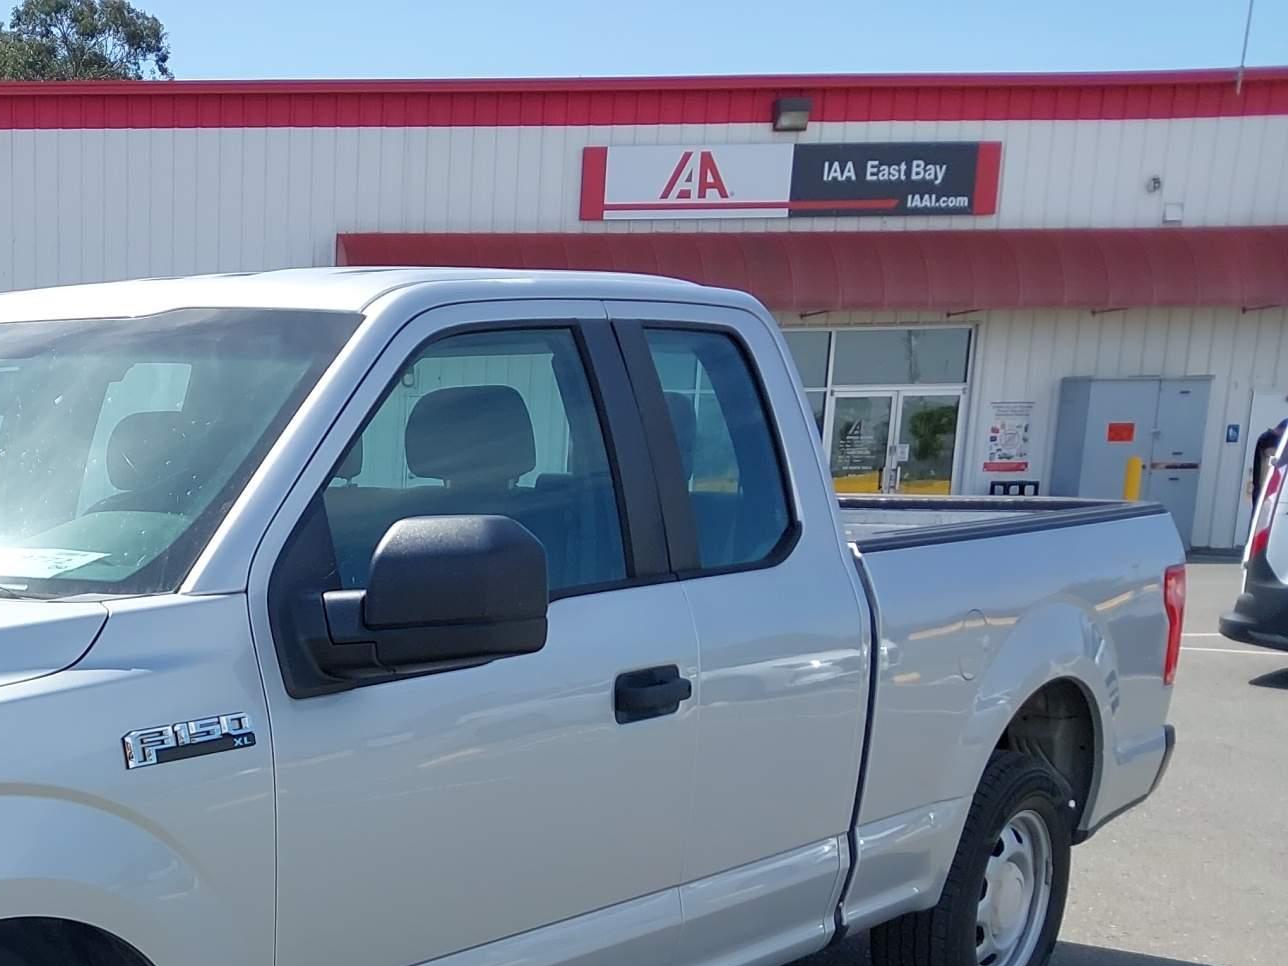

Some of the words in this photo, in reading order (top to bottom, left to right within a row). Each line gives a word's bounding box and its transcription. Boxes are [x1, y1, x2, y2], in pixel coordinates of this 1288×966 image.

[823, 161, 856, 181] IAA
[865, 160, 906, 181] East
[911, 160, 947, 185] Bay
[233, 736, 252, 747] XL
